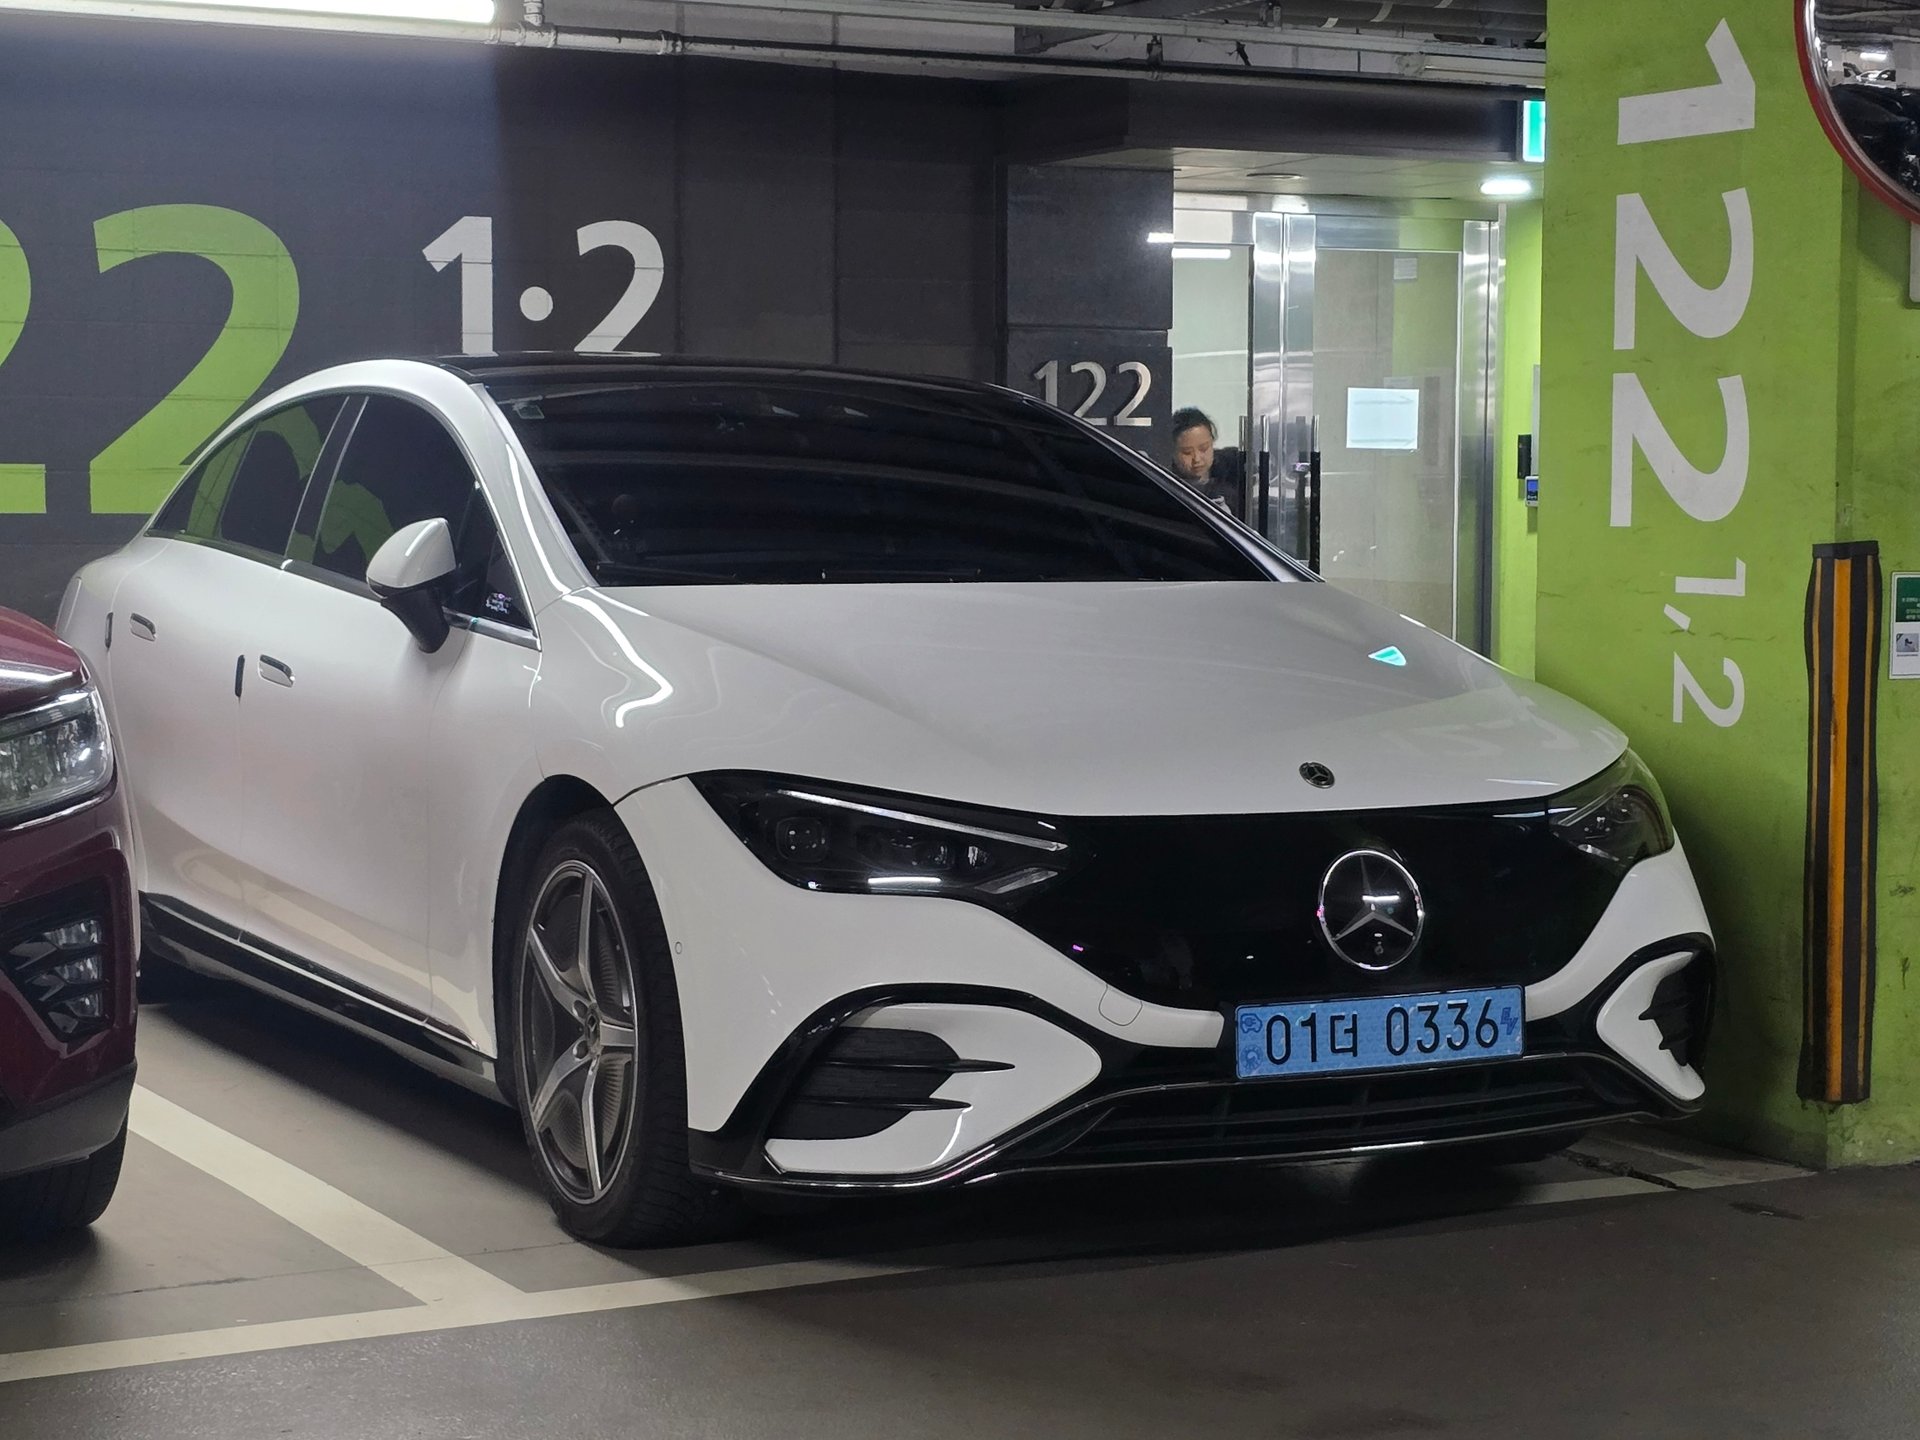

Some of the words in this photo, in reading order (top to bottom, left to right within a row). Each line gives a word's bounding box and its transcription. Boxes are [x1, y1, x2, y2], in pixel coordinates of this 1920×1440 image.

[0, 203, 299, 514] 2
[1610, 17, 1756, 527] 122
[1034, 360, 1152, 427] 122
[1266, 1012, 1358, 1065] 01더
[1386, 998, 1499, 1056] 0336
